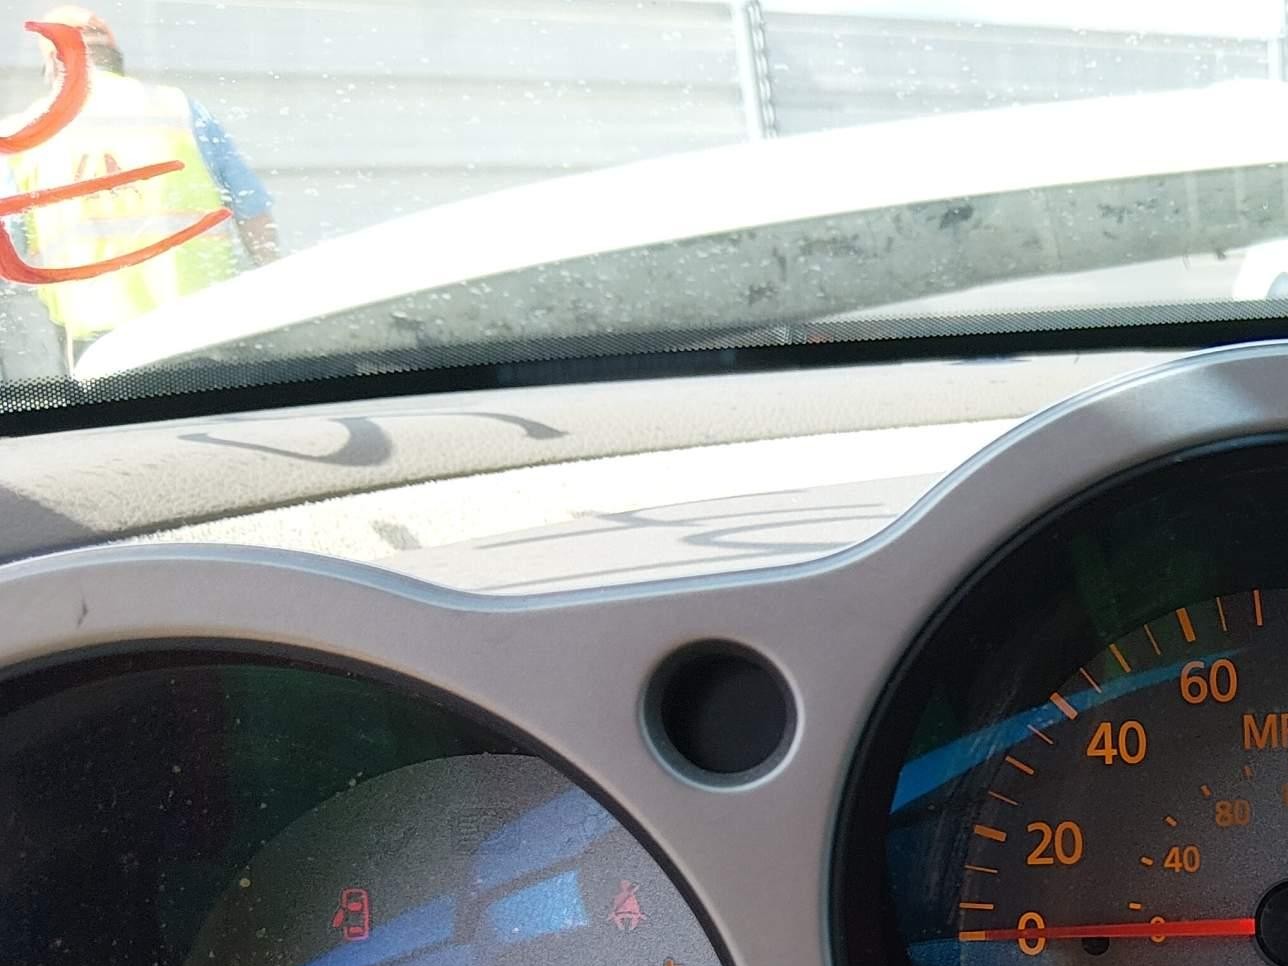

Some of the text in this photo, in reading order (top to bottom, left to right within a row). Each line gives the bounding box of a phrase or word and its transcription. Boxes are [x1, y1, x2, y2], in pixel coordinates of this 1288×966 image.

[1179, 658, 1238, 704] 60
[1086, 720, 1147, 765] 40
[1215, 800, 1251, 828] 80
[1026, 821, 1084, 865] 20
[1163, 846, 1200, 872] 40
[1017, 912, 1046, 956] 0
